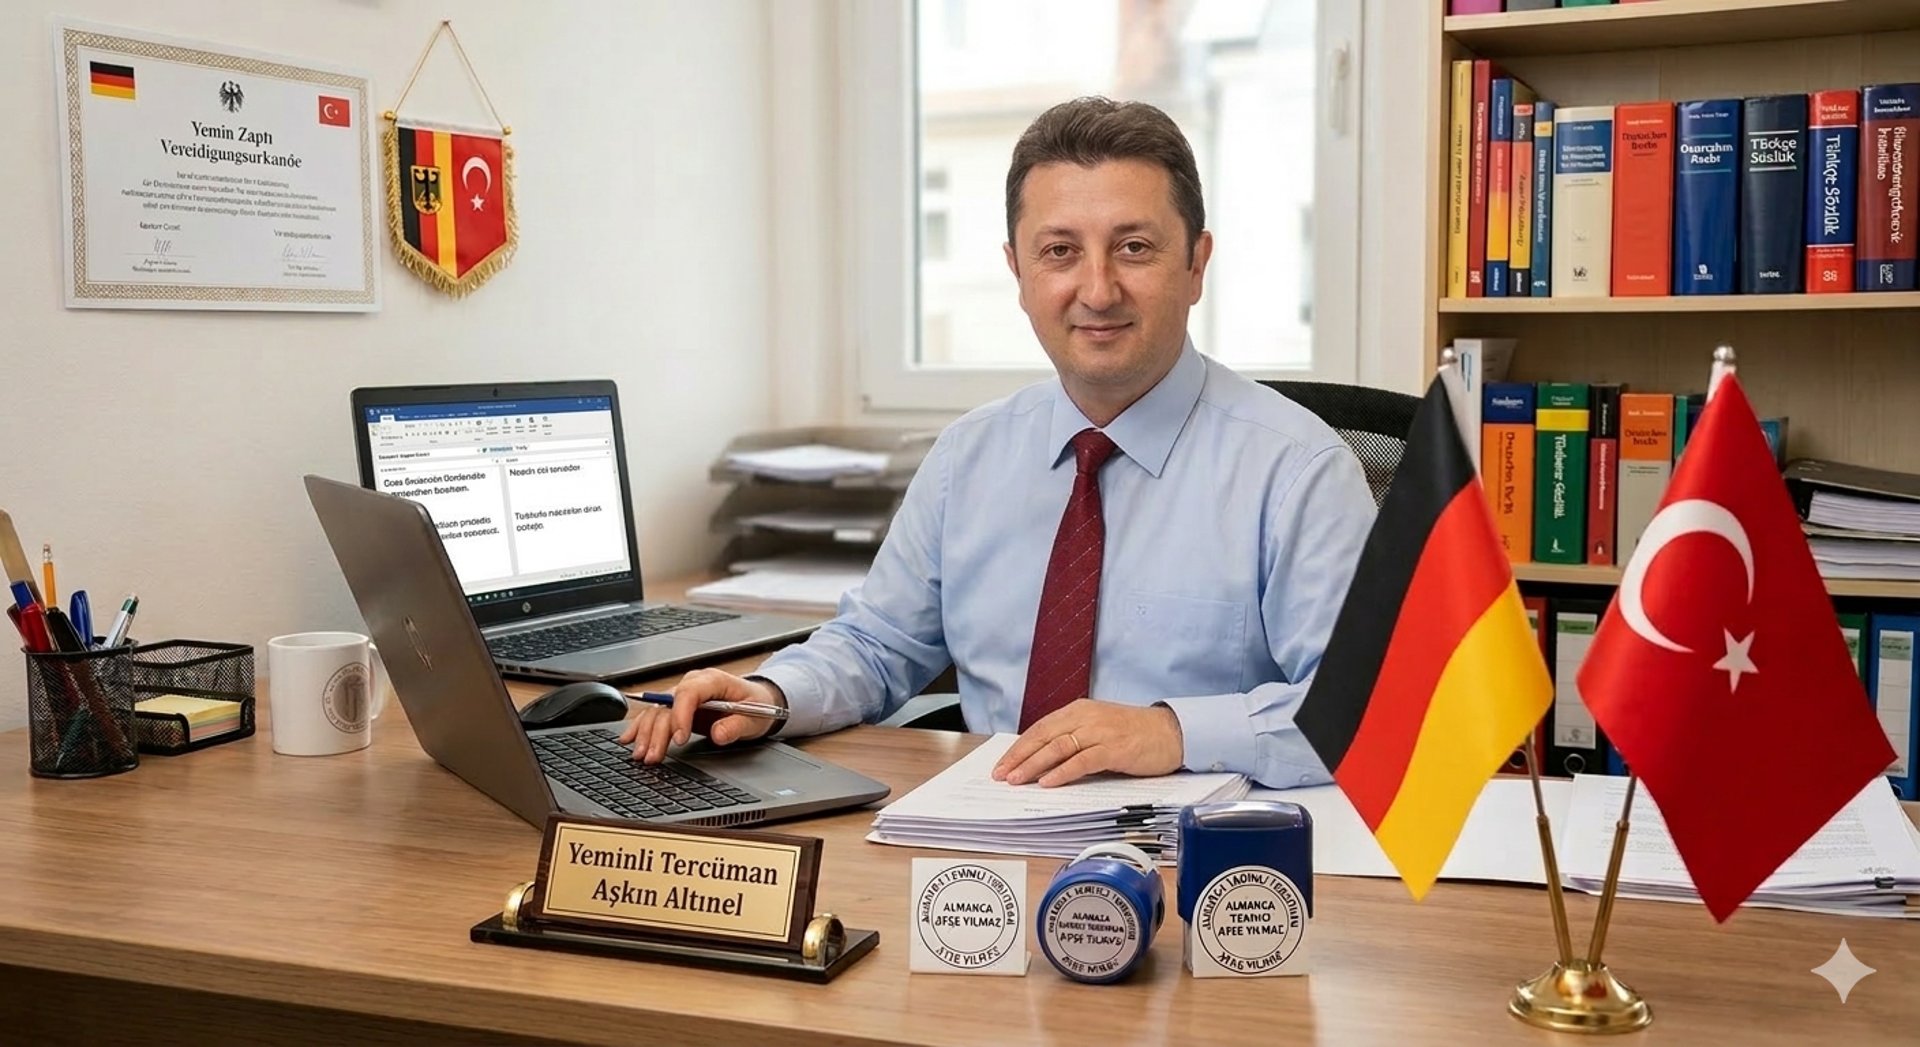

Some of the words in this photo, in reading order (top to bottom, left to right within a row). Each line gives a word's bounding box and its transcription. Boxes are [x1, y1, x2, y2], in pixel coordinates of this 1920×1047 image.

[191, 120, 234, 140] Yemin
[568, 842, 654, 873] Yeminli
[660, 851, 778, 886] Tercüman
[591, 878, 658, 908] Aşkın
[663, 886, 744, 917] Altınel
[1225, 900, 1276, 912] ALMANCA
